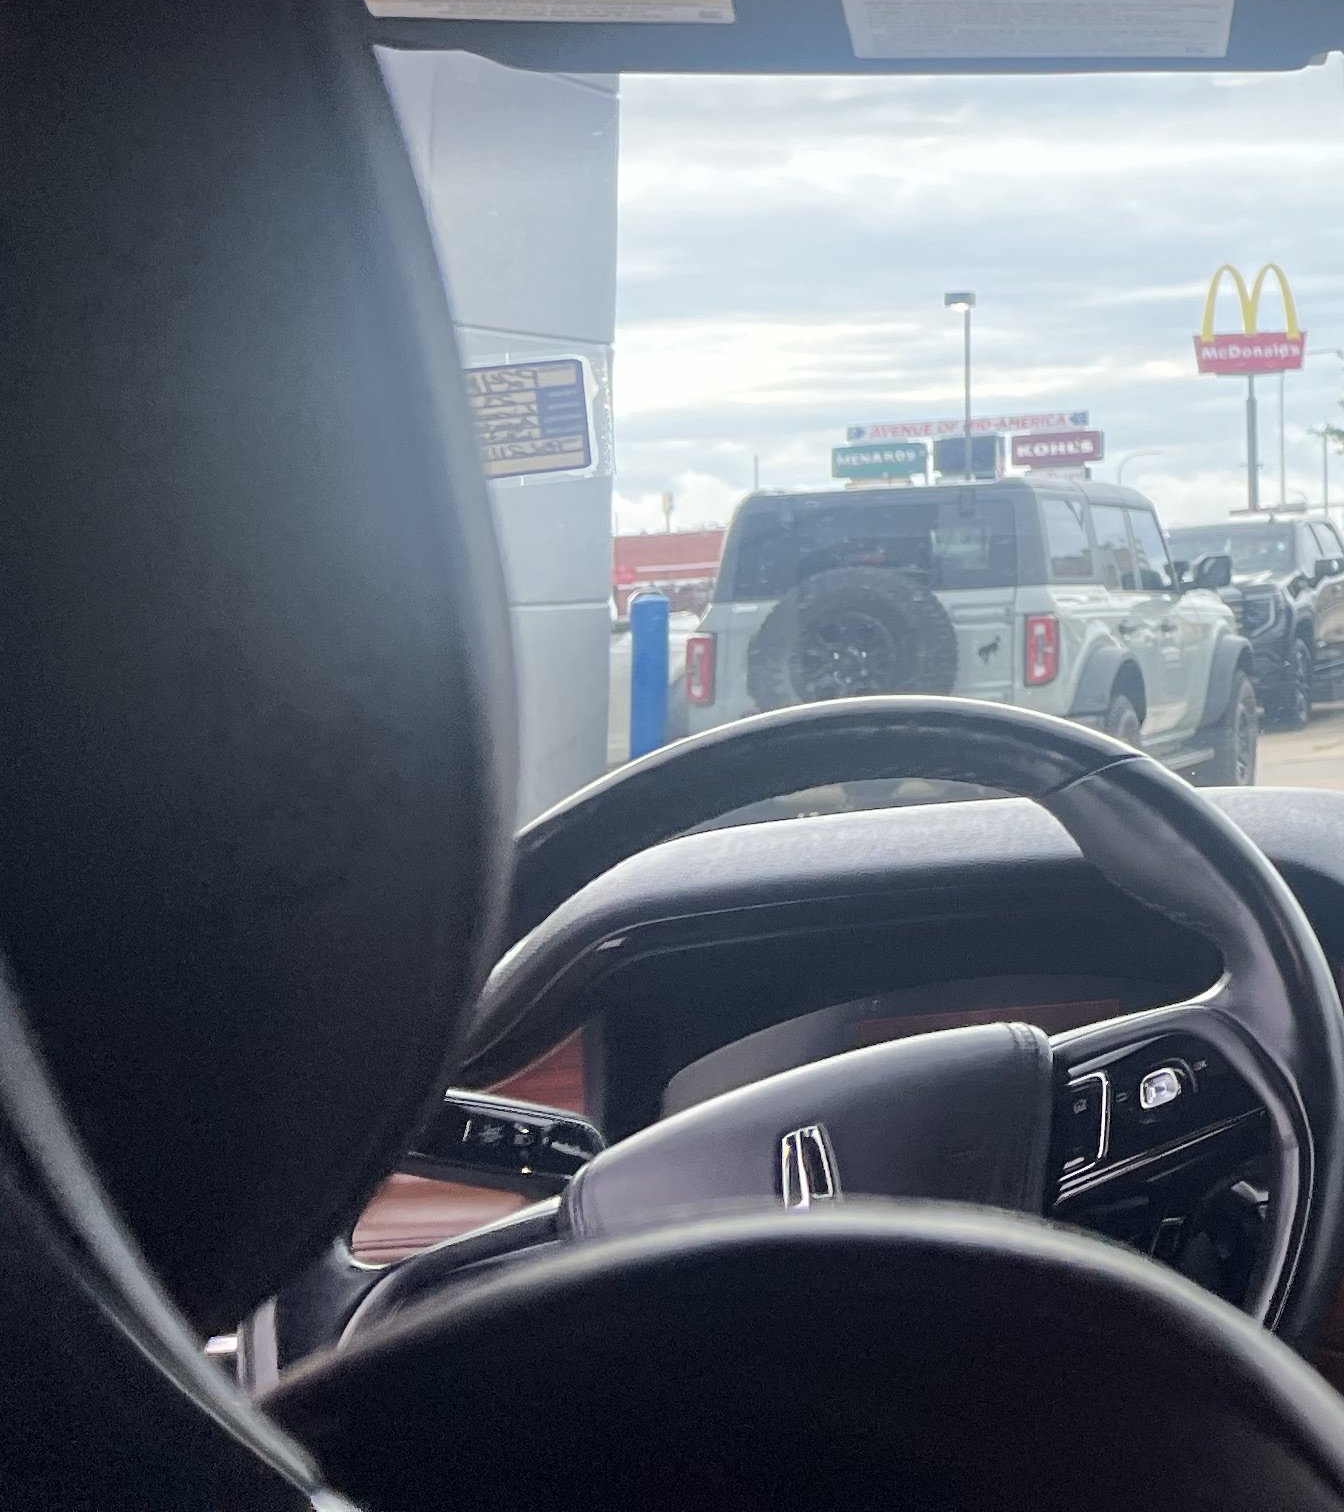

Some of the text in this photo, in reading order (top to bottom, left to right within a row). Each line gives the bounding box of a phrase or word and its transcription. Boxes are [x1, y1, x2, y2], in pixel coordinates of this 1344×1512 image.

[1201, 344, 1300, 360] McDonald's
[869, 424, 933, 439] AVENUE
[1016, 439, 1094, 458] KOHL'S
[836, 449, 917, 466] MENARDS
